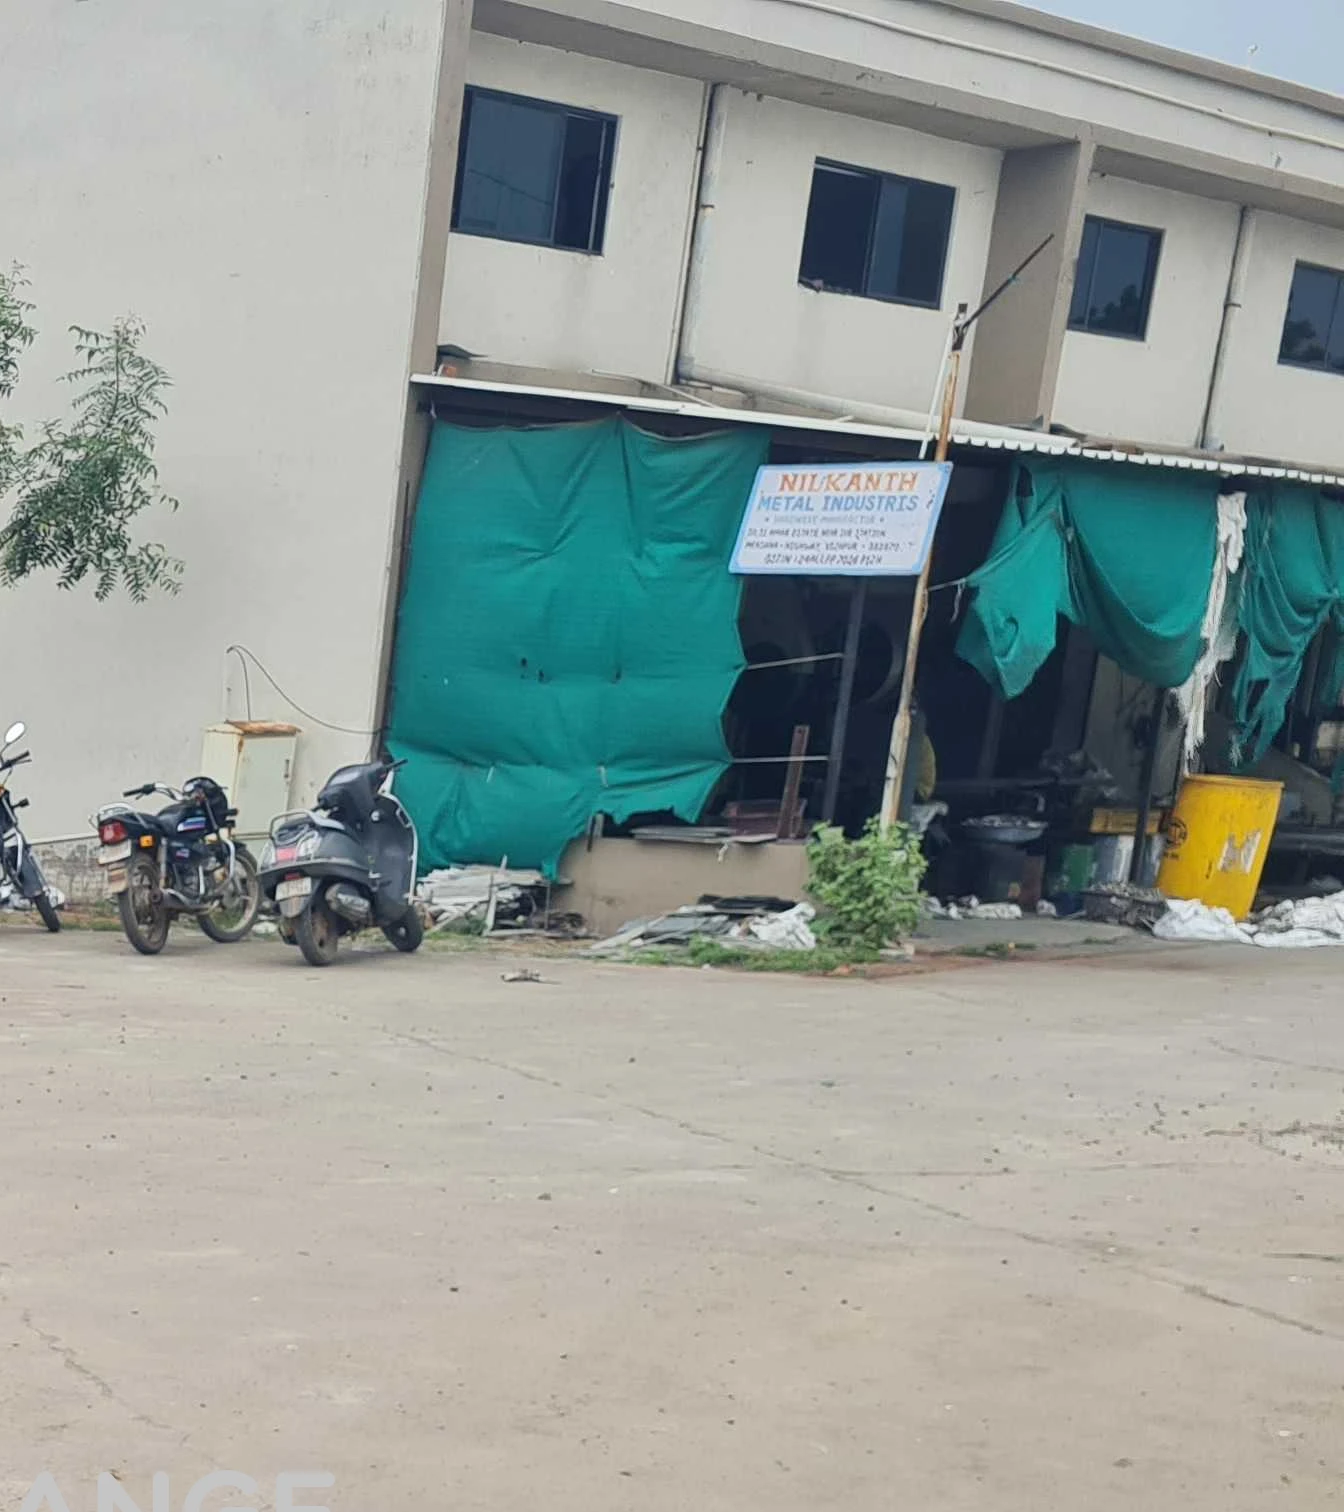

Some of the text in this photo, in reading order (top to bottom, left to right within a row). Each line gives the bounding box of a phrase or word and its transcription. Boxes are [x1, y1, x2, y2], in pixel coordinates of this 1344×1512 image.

[778, 472, 919, 493] NILKANTH
[756, 495, 920, 513] METAL INDUSTRIS
